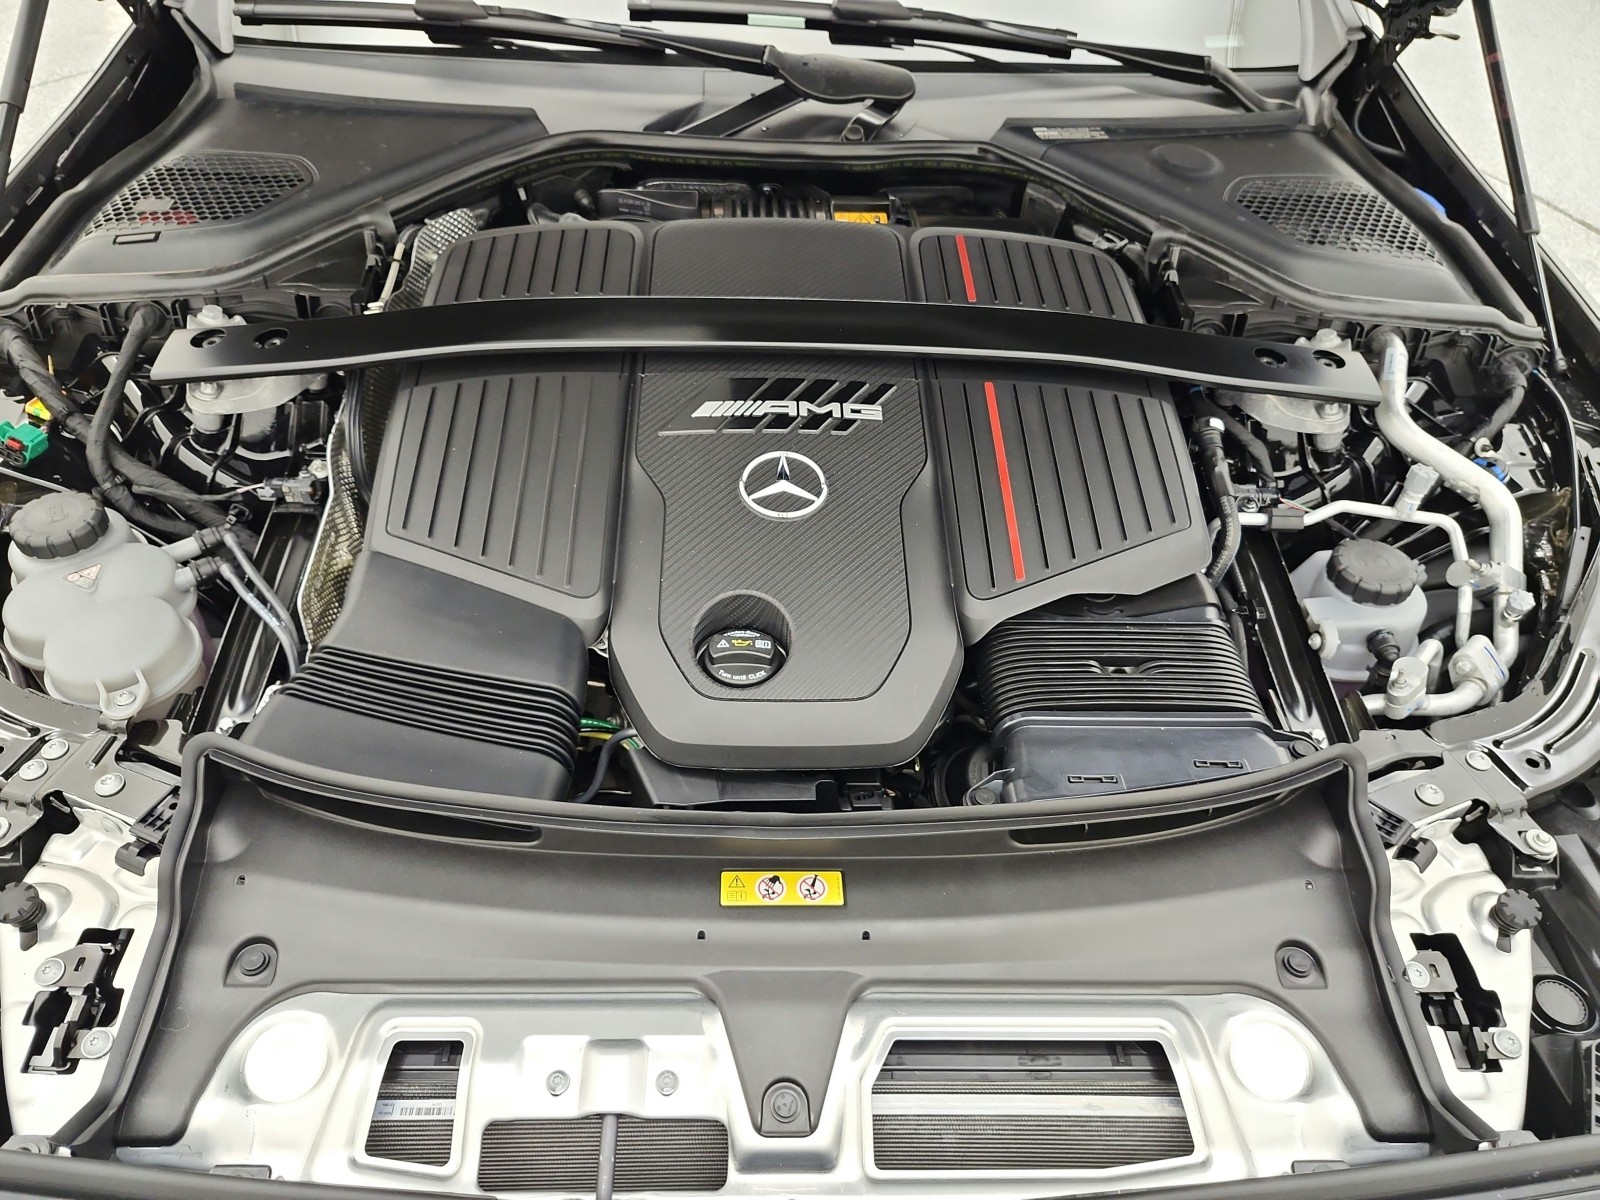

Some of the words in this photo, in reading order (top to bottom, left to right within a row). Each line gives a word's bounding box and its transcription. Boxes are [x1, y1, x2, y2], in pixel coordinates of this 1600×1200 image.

[752, 400, 883, 421] AMG
[718, 669, 732, 679] Turn
[748, 669, 767, 681] CLICK
